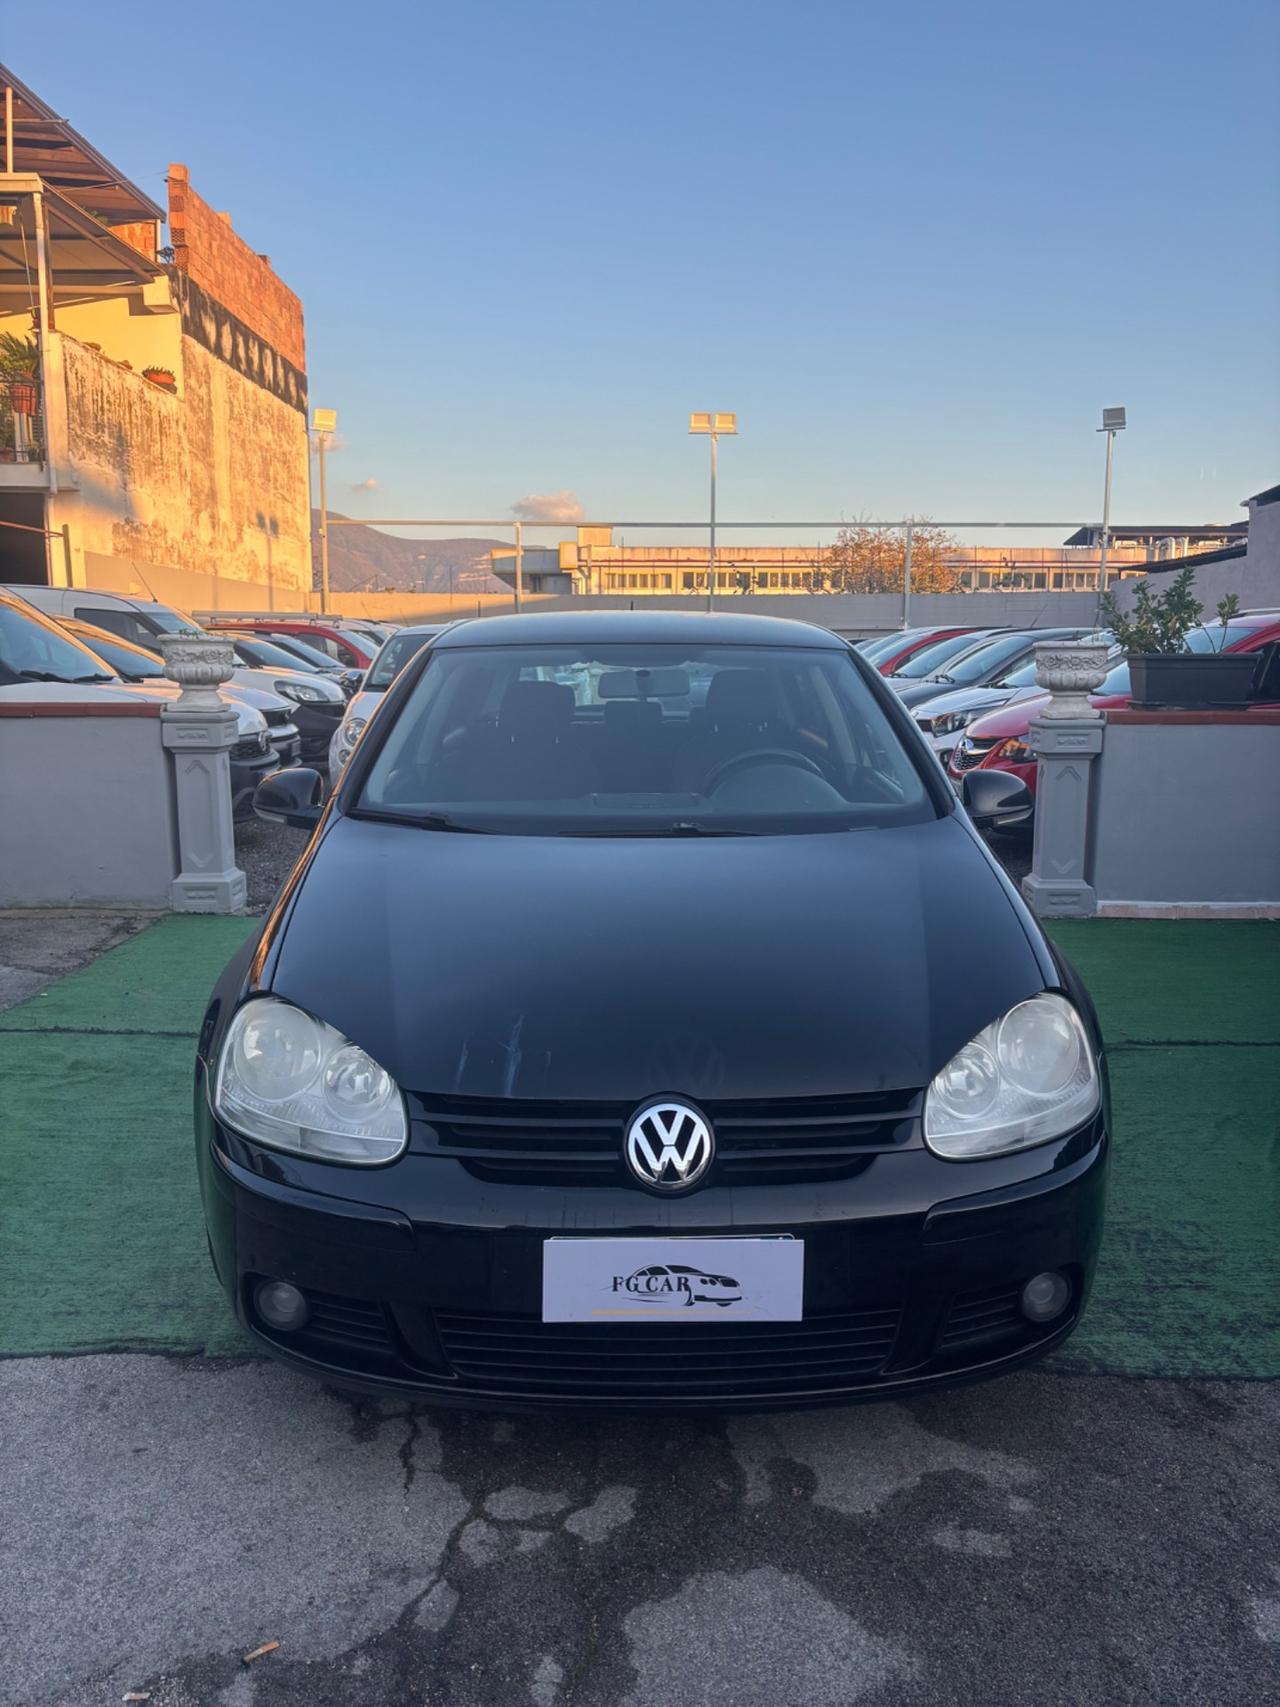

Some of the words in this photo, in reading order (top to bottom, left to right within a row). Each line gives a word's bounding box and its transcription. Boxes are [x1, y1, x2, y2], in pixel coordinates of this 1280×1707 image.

[630, 1105, 709, 1184] VW
[612, 1276, 640, 1293] FG
[645, 1276, 690, 1293] CAR
